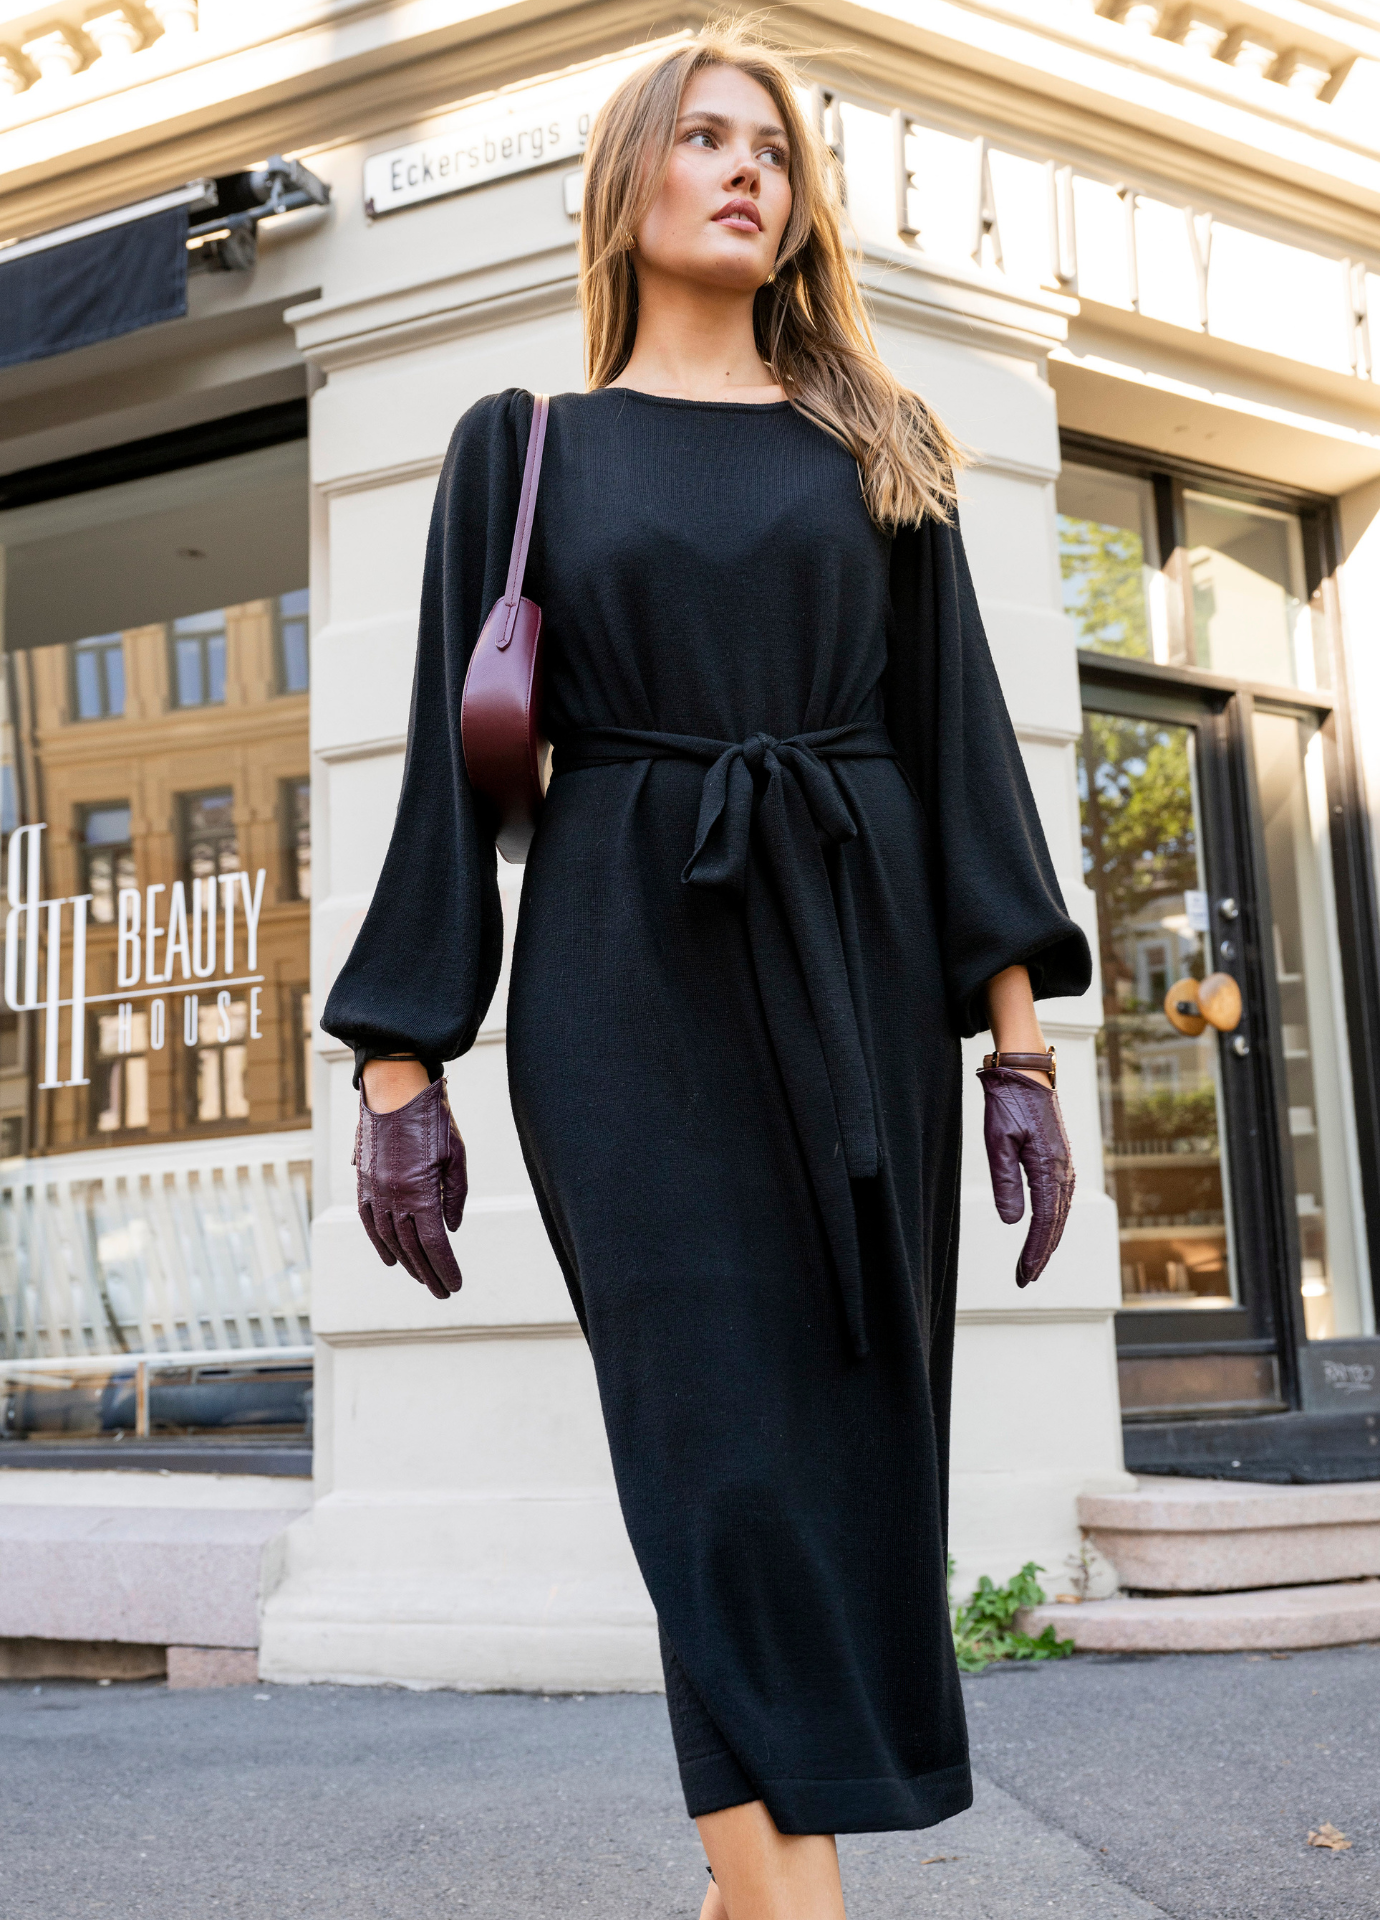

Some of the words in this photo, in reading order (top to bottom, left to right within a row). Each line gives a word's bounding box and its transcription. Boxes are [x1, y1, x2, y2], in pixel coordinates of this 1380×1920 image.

[391, 122, 561, 192] Eckersbergs
[117, 868, 267, 988] BEAUTY
[118, 986, 263, 1054] HOUSE
